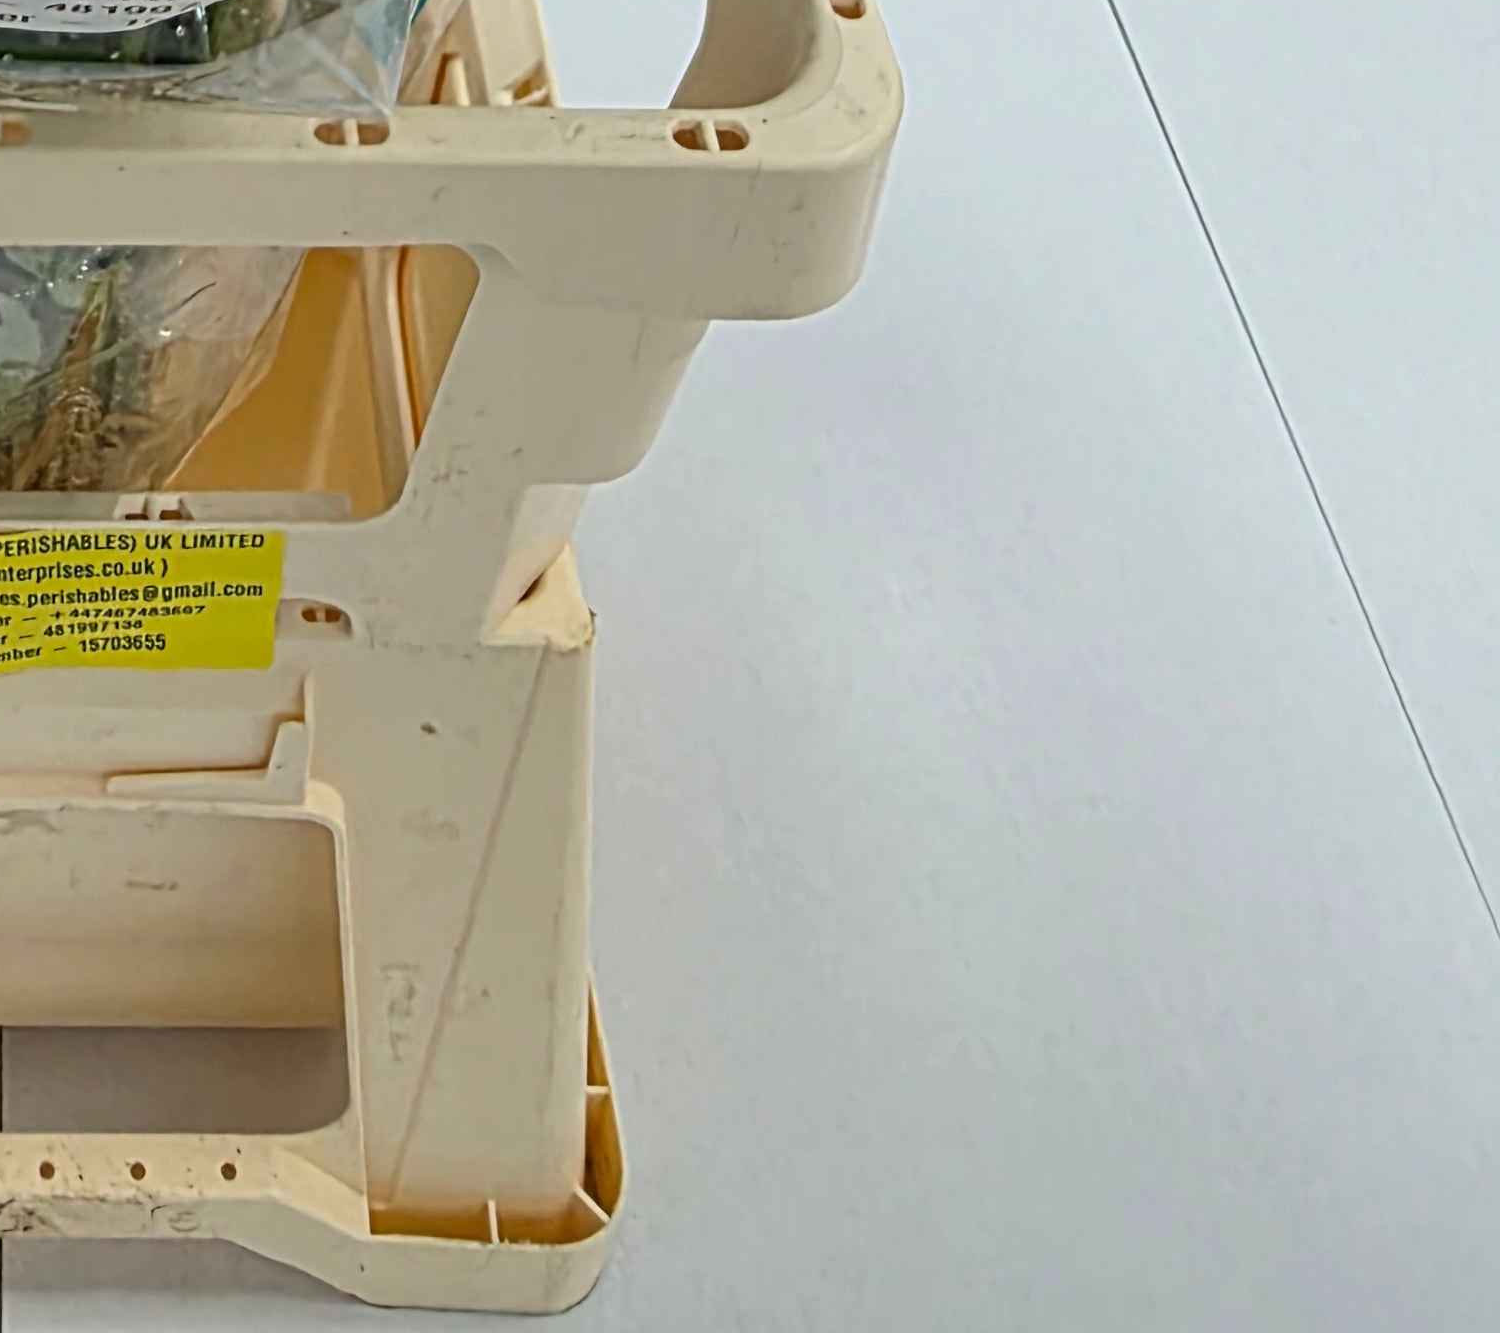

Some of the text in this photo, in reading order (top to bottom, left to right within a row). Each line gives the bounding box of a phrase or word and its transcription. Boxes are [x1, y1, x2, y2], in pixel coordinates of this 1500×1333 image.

[145, 533, 172, 551] UK
[181, 533, 264, 549] LIMITED
[79, 633, 167, 652] 15703655
